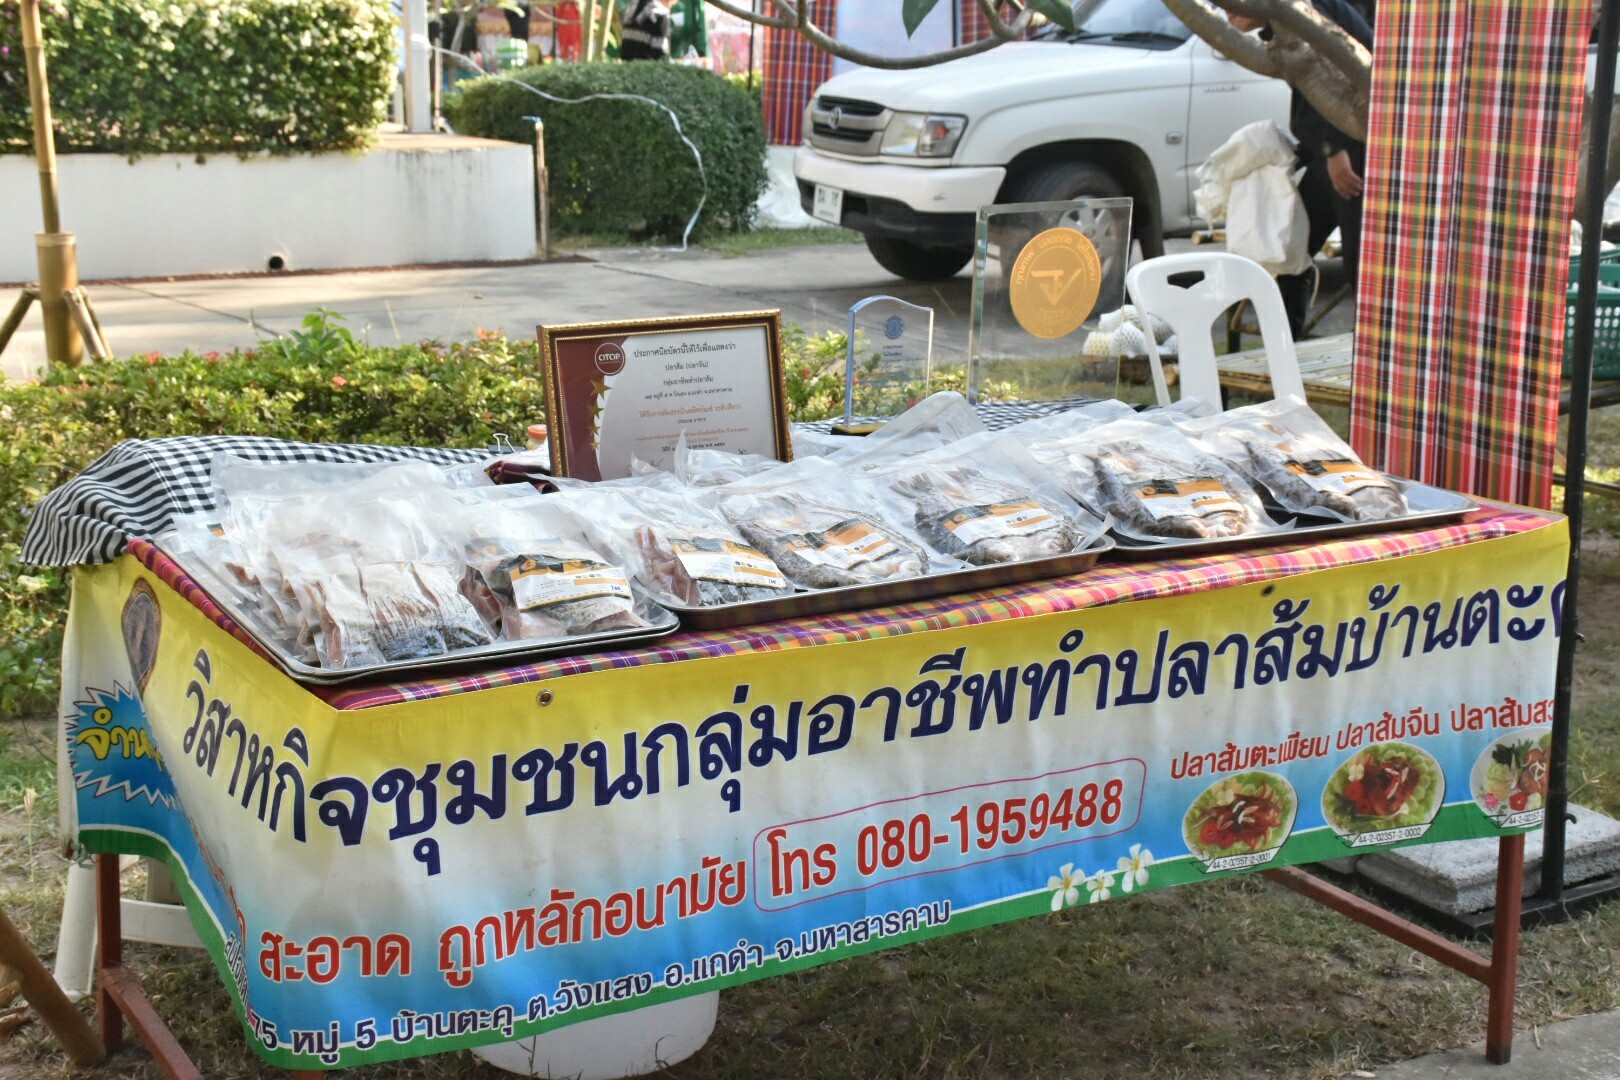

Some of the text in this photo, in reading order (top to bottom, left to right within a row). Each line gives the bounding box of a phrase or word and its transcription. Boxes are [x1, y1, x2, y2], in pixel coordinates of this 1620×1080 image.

[598, 353, 621, 361] OTOP
[1170, 731, 1330, 780] ปลาส้มตะเพียน
[1336, 706, 1441, 751] ปลาส้มจีน
[766, 779, 1124, 897] โทร 080-1959488
[1358, 827, 1422, 844] 44-2-02357-2-0002
[259, 856, 747, 987] สะอาด ถูกหลักอนามัย
[250, 901, 951, 1064] 75 หมู่ 5 บ้านตะคุ ต.วังแสง อ.แกดำ จ.มหาสารคาม
